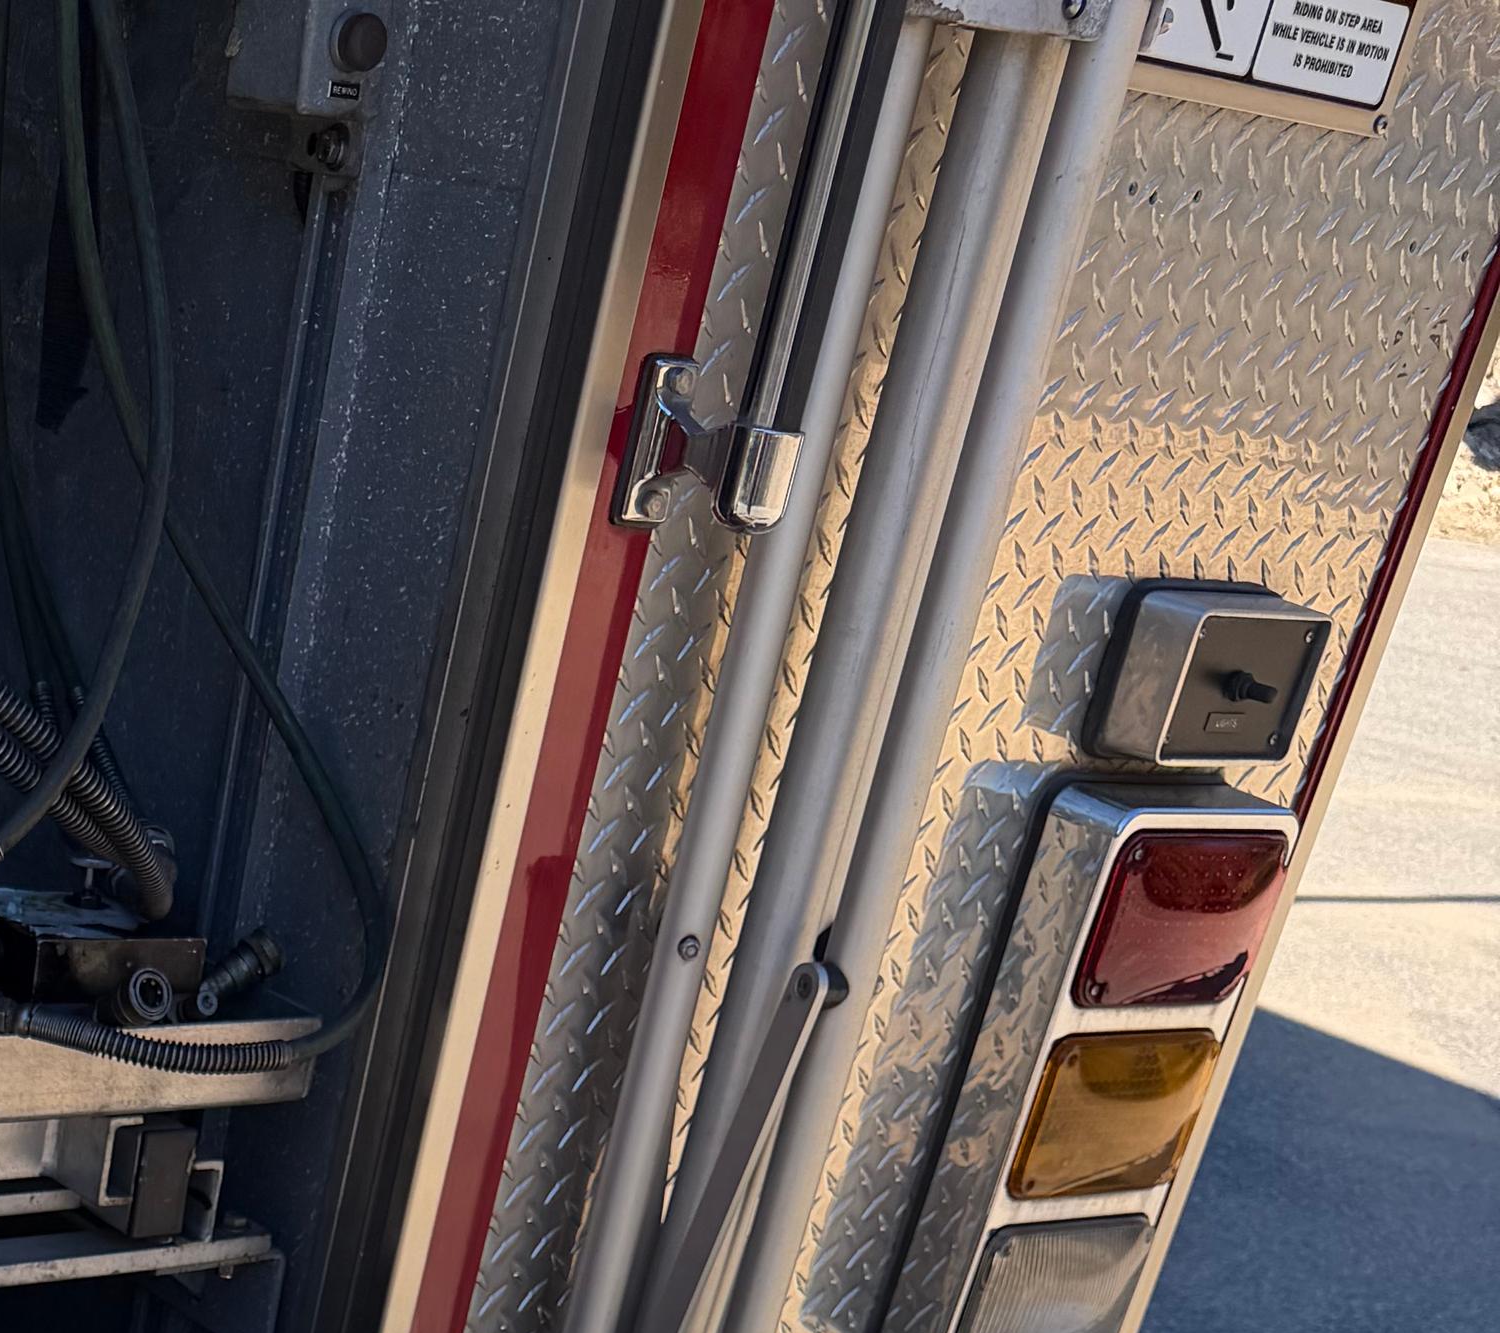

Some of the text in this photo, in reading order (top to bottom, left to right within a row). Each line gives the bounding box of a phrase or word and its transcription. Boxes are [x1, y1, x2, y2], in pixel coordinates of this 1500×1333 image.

[1293, 1, 1383, 34] RIDING ON STEP AREA
[1272, 22, 1390, 61] WHILE VEHICLE IS IN MOTION
[1293, 53, 1353, 78] IS PROHIBITED
[333, 85, 357, 96] REWIND
